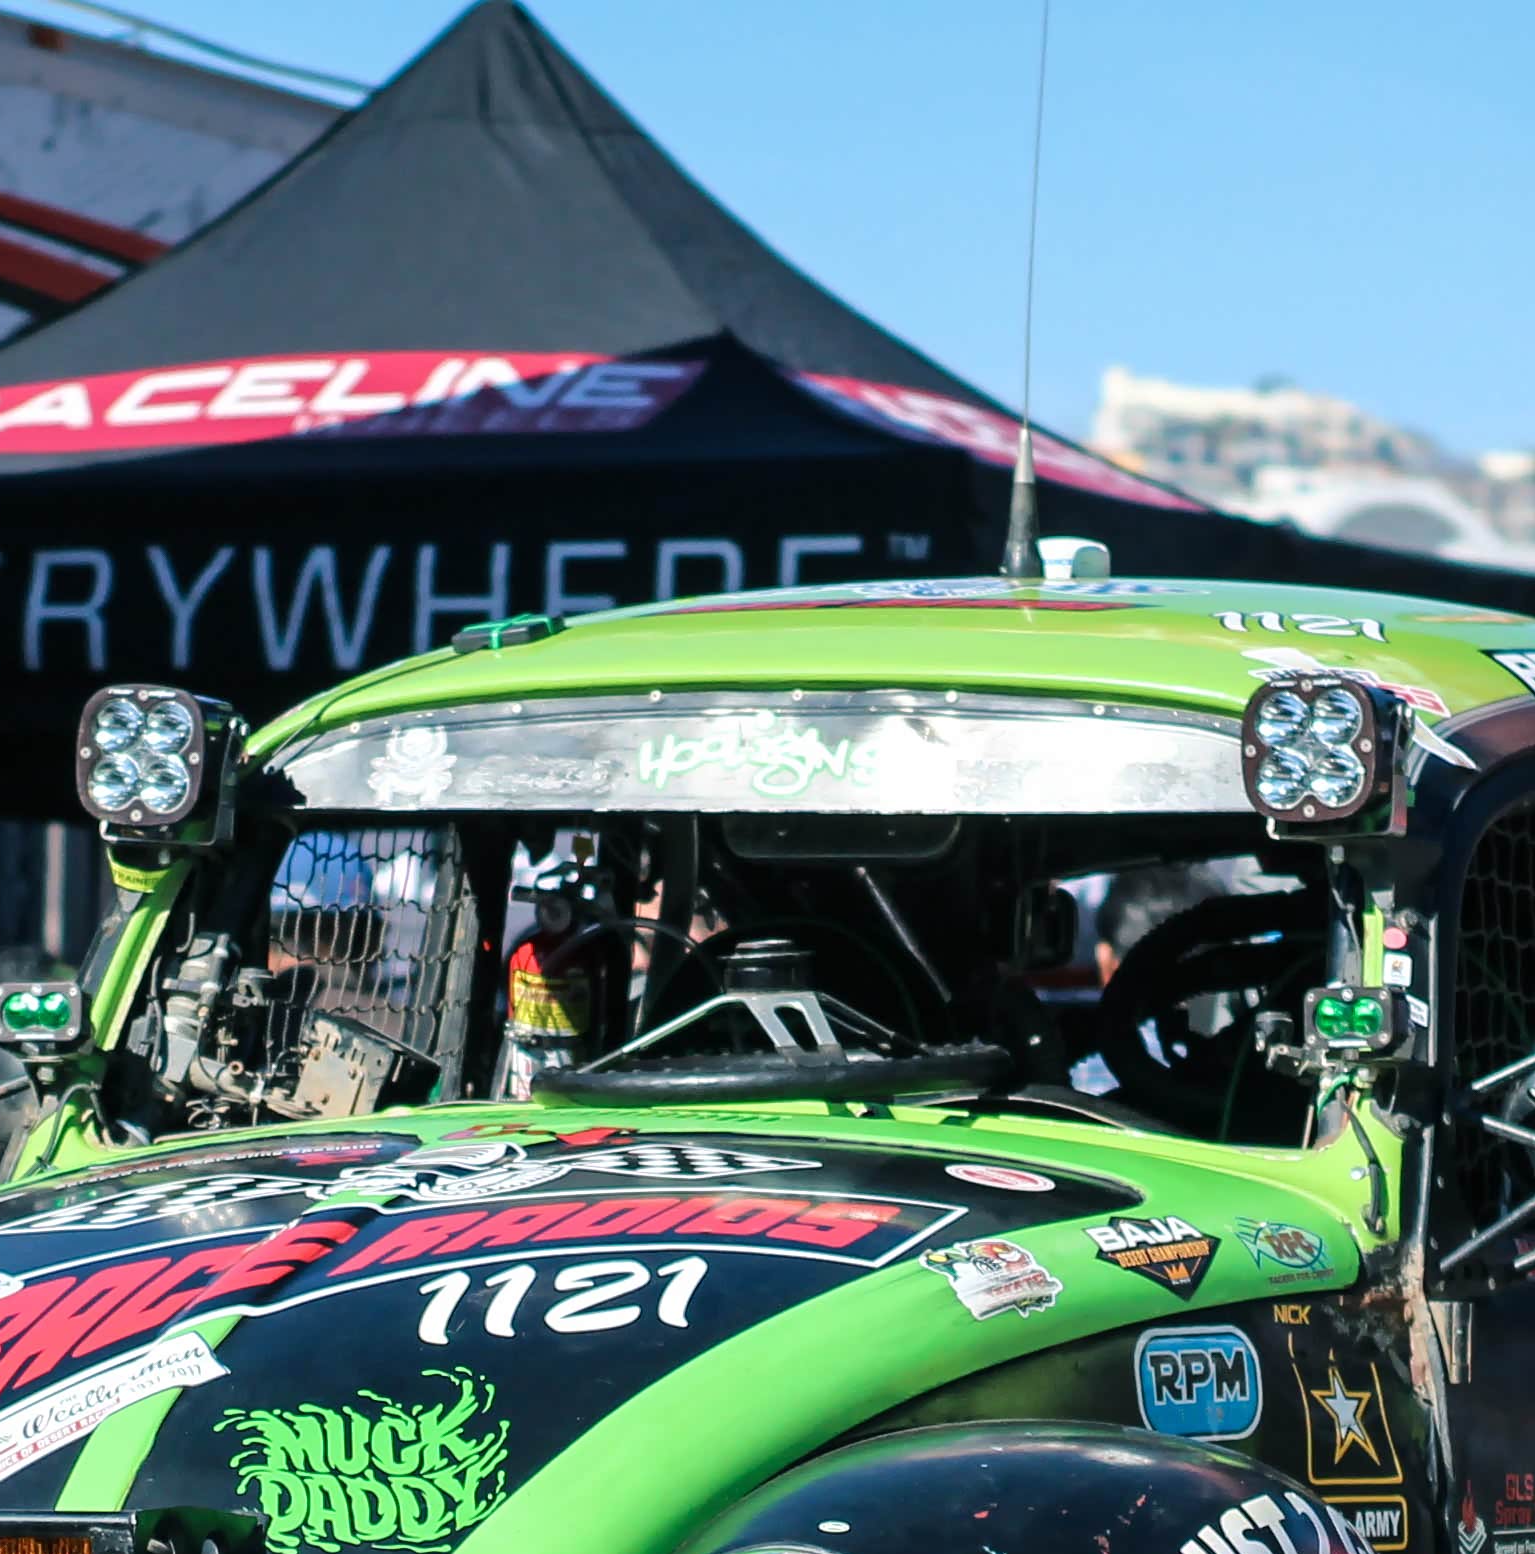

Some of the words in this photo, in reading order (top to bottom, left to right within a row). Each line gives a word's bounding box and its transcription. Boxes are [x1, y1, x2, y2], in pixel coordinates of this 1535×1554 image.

[1211, 609, 1390, 643] 1121
[327, 1196, 901, 1278] RADIOS
[1084, 1215, 1203, 1252] BAJA
[417, 1255, 709, 1346] 1121
[1273, 1304, 1312, 1326] NICK
[1147, 1347, 1251, 1407] RPM
[260, 1385, 484, 1476] MUCK
[258, 1465, 504, 1552] DADDY
[1354, 1509, 1401, 1538] ARMY
